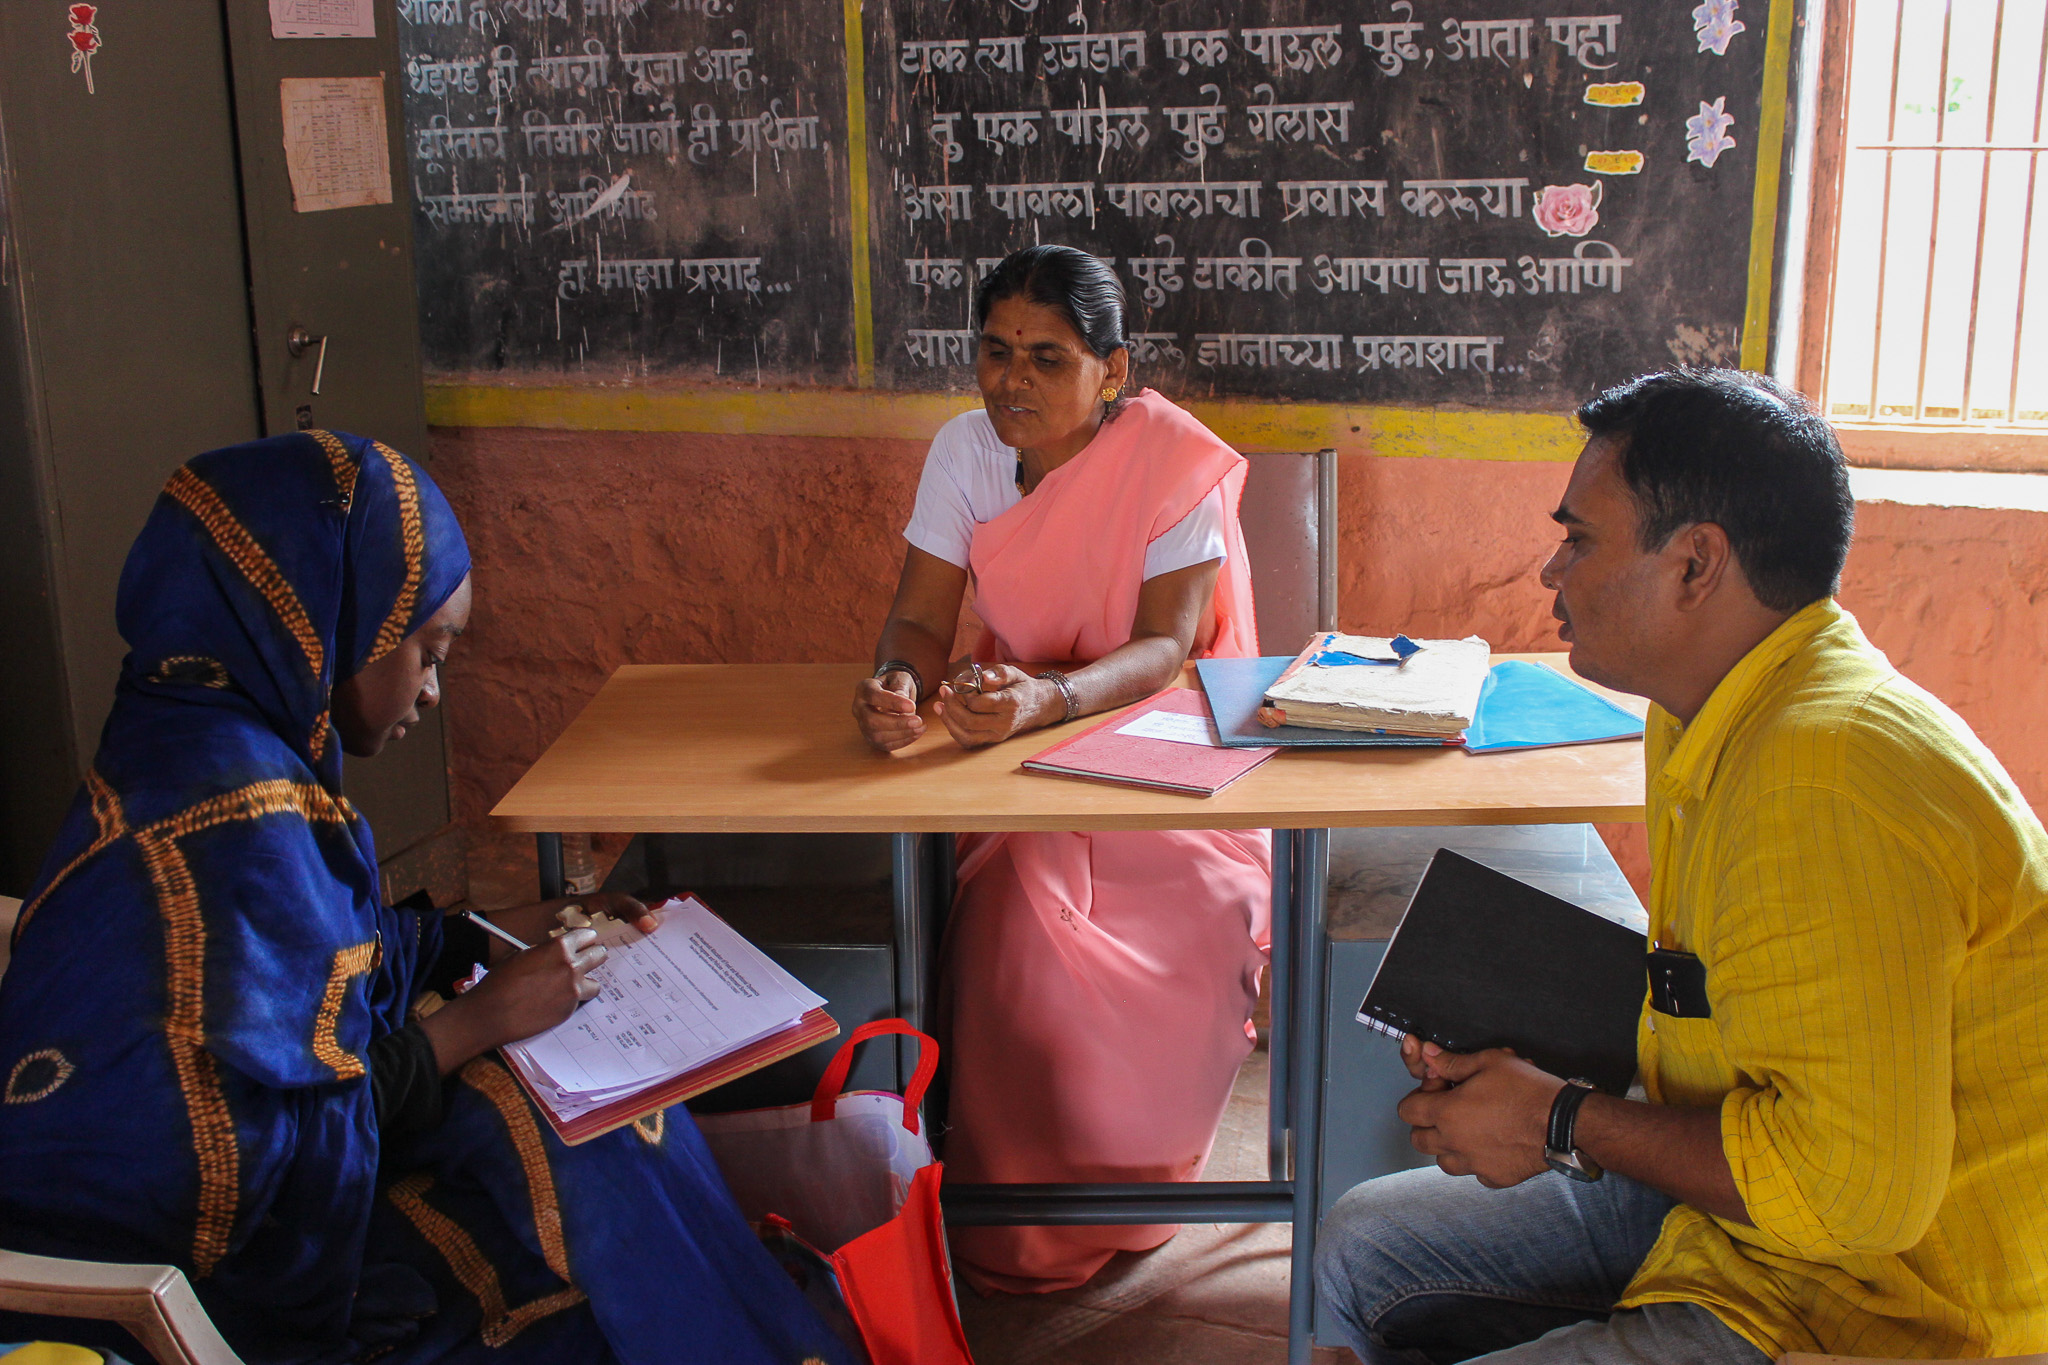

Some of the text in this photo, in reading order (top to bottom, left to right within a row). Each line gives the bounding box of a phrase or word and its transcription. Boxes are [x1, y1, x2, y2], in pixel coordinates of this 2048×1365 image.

[900, 39, 970, 74] टाक
[974, 36, 1026, 76] त्या
[1040, 12, 1147, 76] उजेडात
[1162, 29, 1229, 76] एक
[1241, 24, 1342, 74] पाऊल
[1437, 17, 1534, 67] आता
[1545, 15, 1622, 69] पहा
[620, 52, 688, 96] पूजा
[689, 104, 721, 164] ही
[728, 98, 819, 157] प्रार्थना
[973, 110, 1042, 156] एक
[1050, 106, 1151, 151] पाऊल
[1162, 83, 1227, 165] पुढे
[1246, 83, 1355, 144] गेलास
[902, 183, 972, 223] असा
[986, 181, 1096, 220] पावला
[1277, 180, 1388, 222] प्रवास
[558, 260, 588, 300] हा
[600, 258, 674, 294] माझा
[905, 257, 963, 295] एक
[1128, 235, 1186, 308] पुढे
[1193, 238, 1302, 300] टाकीत
[1308, 254, 1430, 295] आपण
[1517, 240, 1633, 294] आणि
[905, 329, 974, 368] सारा
[1195, 334, 1343, 371] ज्ञानाच्या
